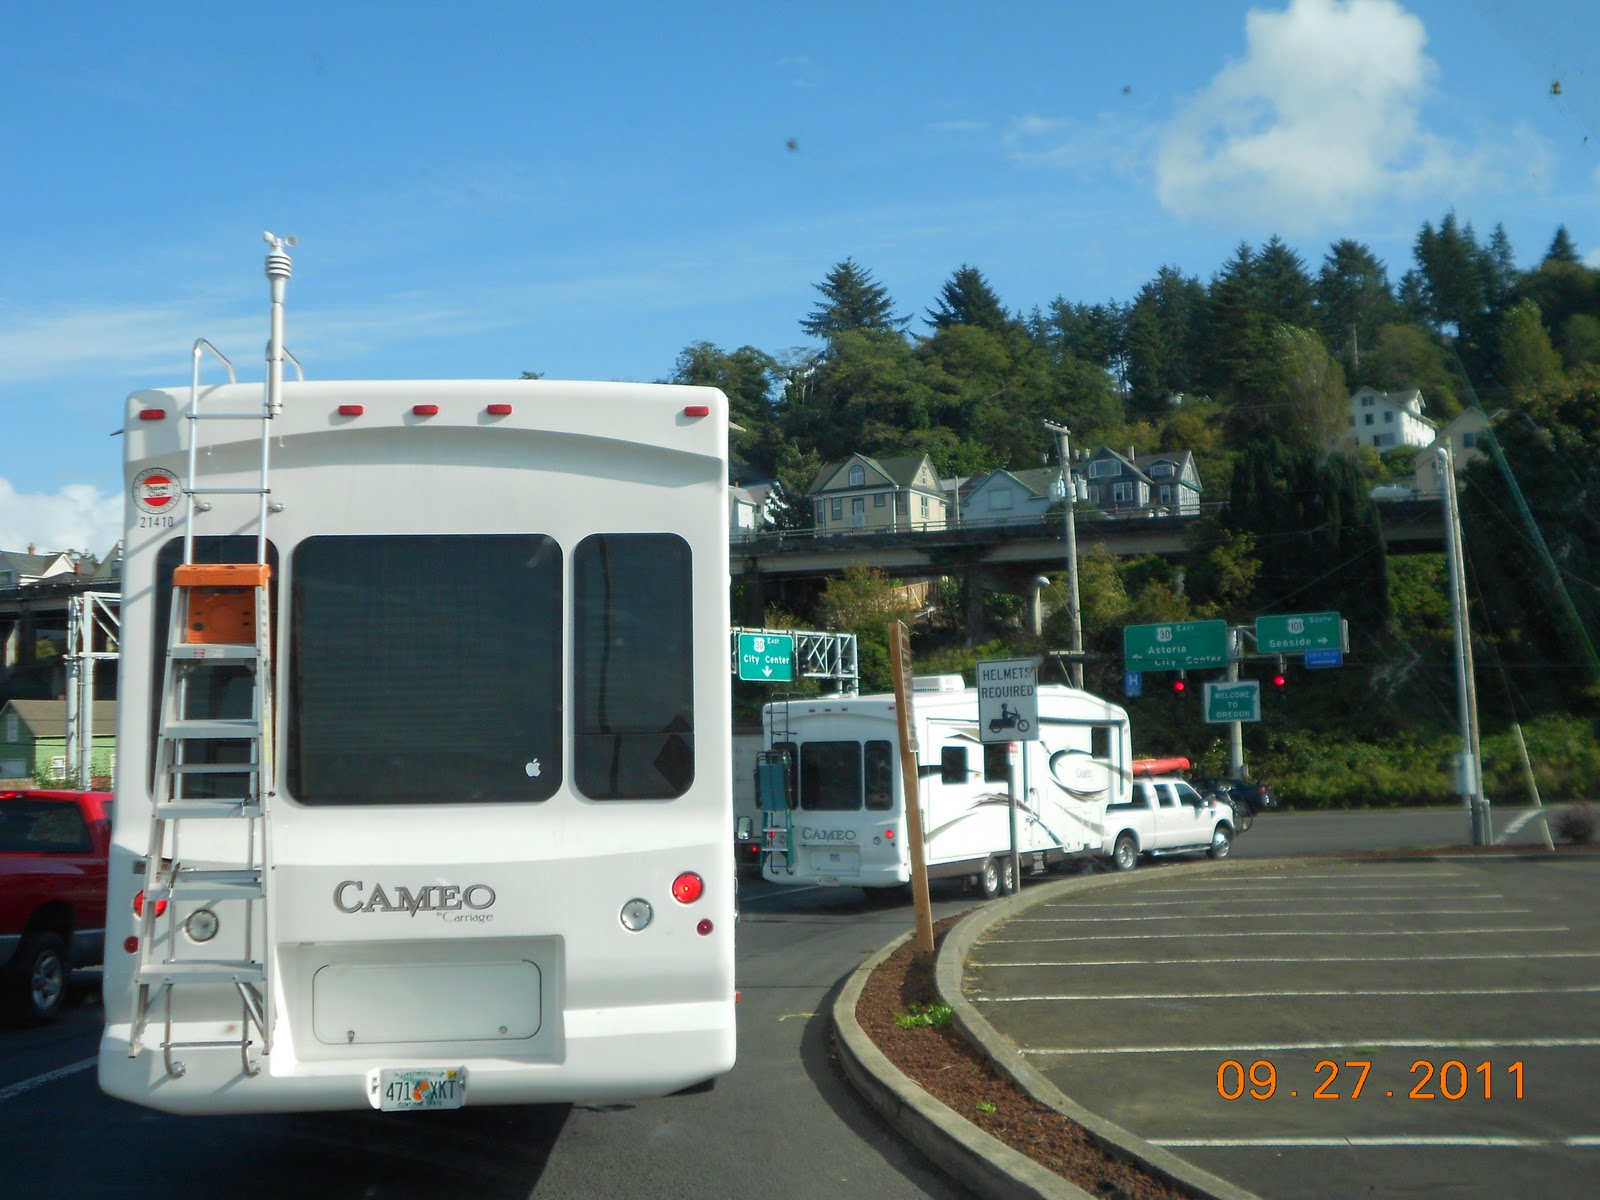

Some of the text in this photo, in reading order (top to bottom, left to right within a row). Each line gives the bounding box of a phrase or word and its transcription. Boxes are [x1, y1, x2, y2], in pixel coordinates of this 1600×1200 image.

[140, 516, 174, 528] 21410
[1290, 621, 1302, 631] 101
[1160, 630, 1170, 639] 30
[1269, 638, 1312, 648] Seaside
[1148, 645, 1187, 655] Astoria
[743, 654, 790, 665] City Center
[1186, 656, 1222, 665] Center
[982, 667, 1032, 681] HELMETS
[981, 685, 1034, 699] REQUIRED
[1215, 691, 1250, 699] WELCOME
[802, 827, 857, 842] CAMEO
[332, 880, 497, 918] CAMEO
[442, 911, 494, 923] Carriage
[386, 1080, 457, 1101] 471 XKT
